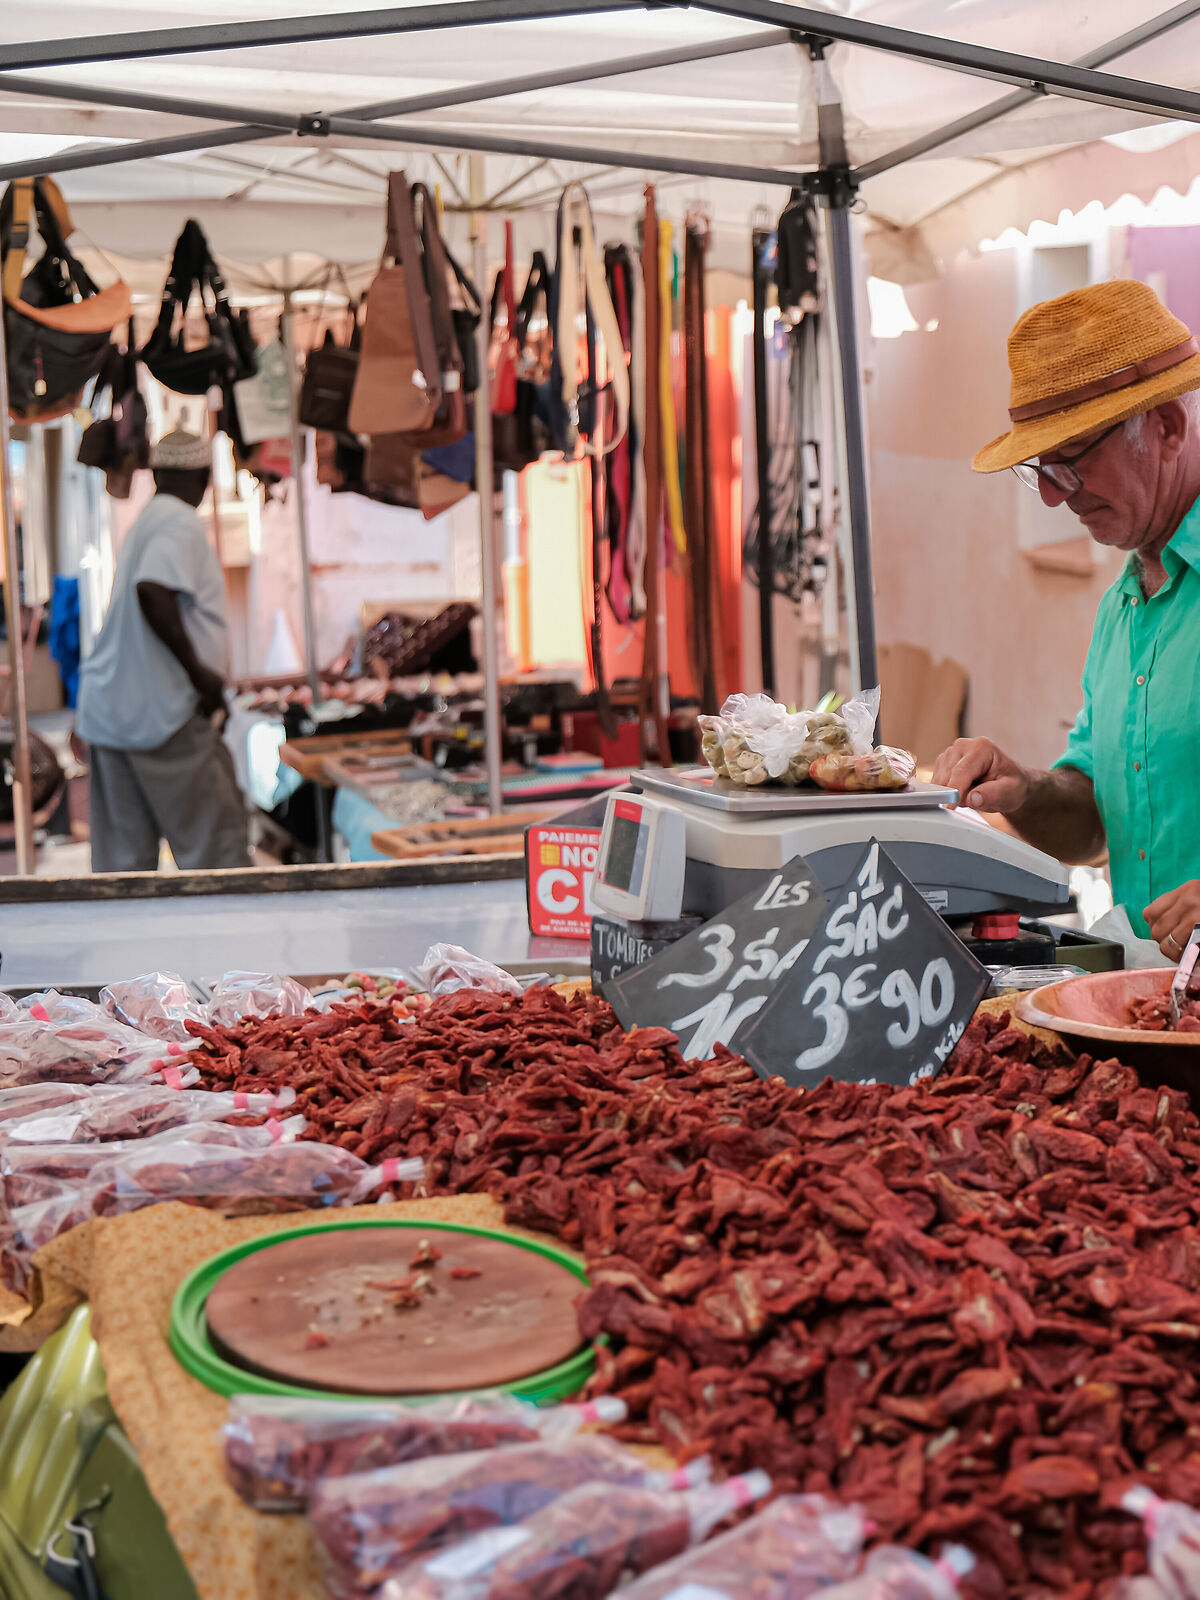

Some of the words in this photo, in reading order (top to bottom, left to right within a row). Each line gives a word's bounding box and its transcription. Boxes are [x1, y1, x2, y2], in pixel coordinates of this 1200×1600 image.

[538, 831, 600, 845] PAIEME
[562, 845, 599, 868] NO
[753, 874, 812, 911] LES
[857, 842, 884, 900] 1
[813, 884, 909, 974] SAC
[656, 923, 736, 989] 3
[725, 926, 811, 991] SA
